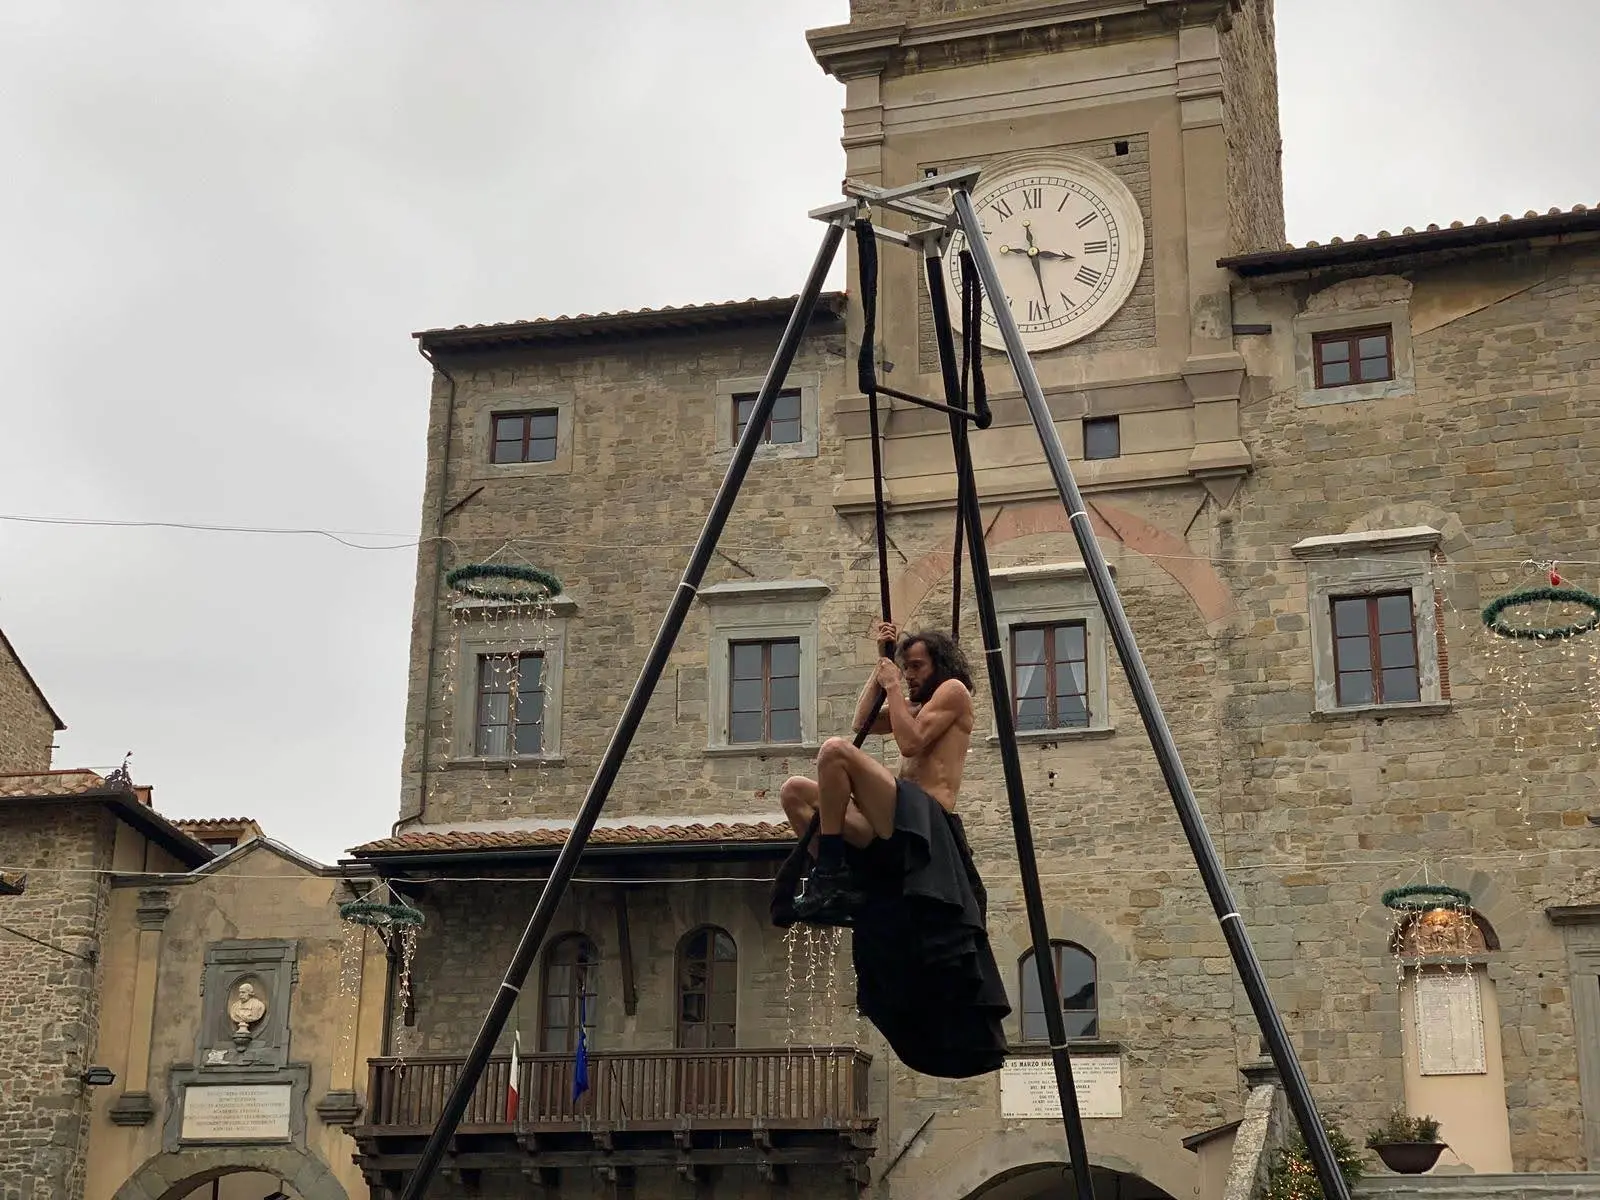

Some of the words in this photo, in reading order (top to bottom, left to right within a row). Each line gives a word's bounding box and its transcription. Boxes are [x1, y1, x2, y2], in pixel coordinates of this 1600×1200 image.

[990, 198, 1013, 222] XI
[1022, 187, 1042, 211] XII
[1057, 192, 1071, 213] I
[1075, 211, 1099, 229] II
[1083, 240, 1108, 255] III
[1074, 265, 1103, 288] IIII
[1028, 299, 1043, 322] VI
[1060, 291, 1077, 311] V
